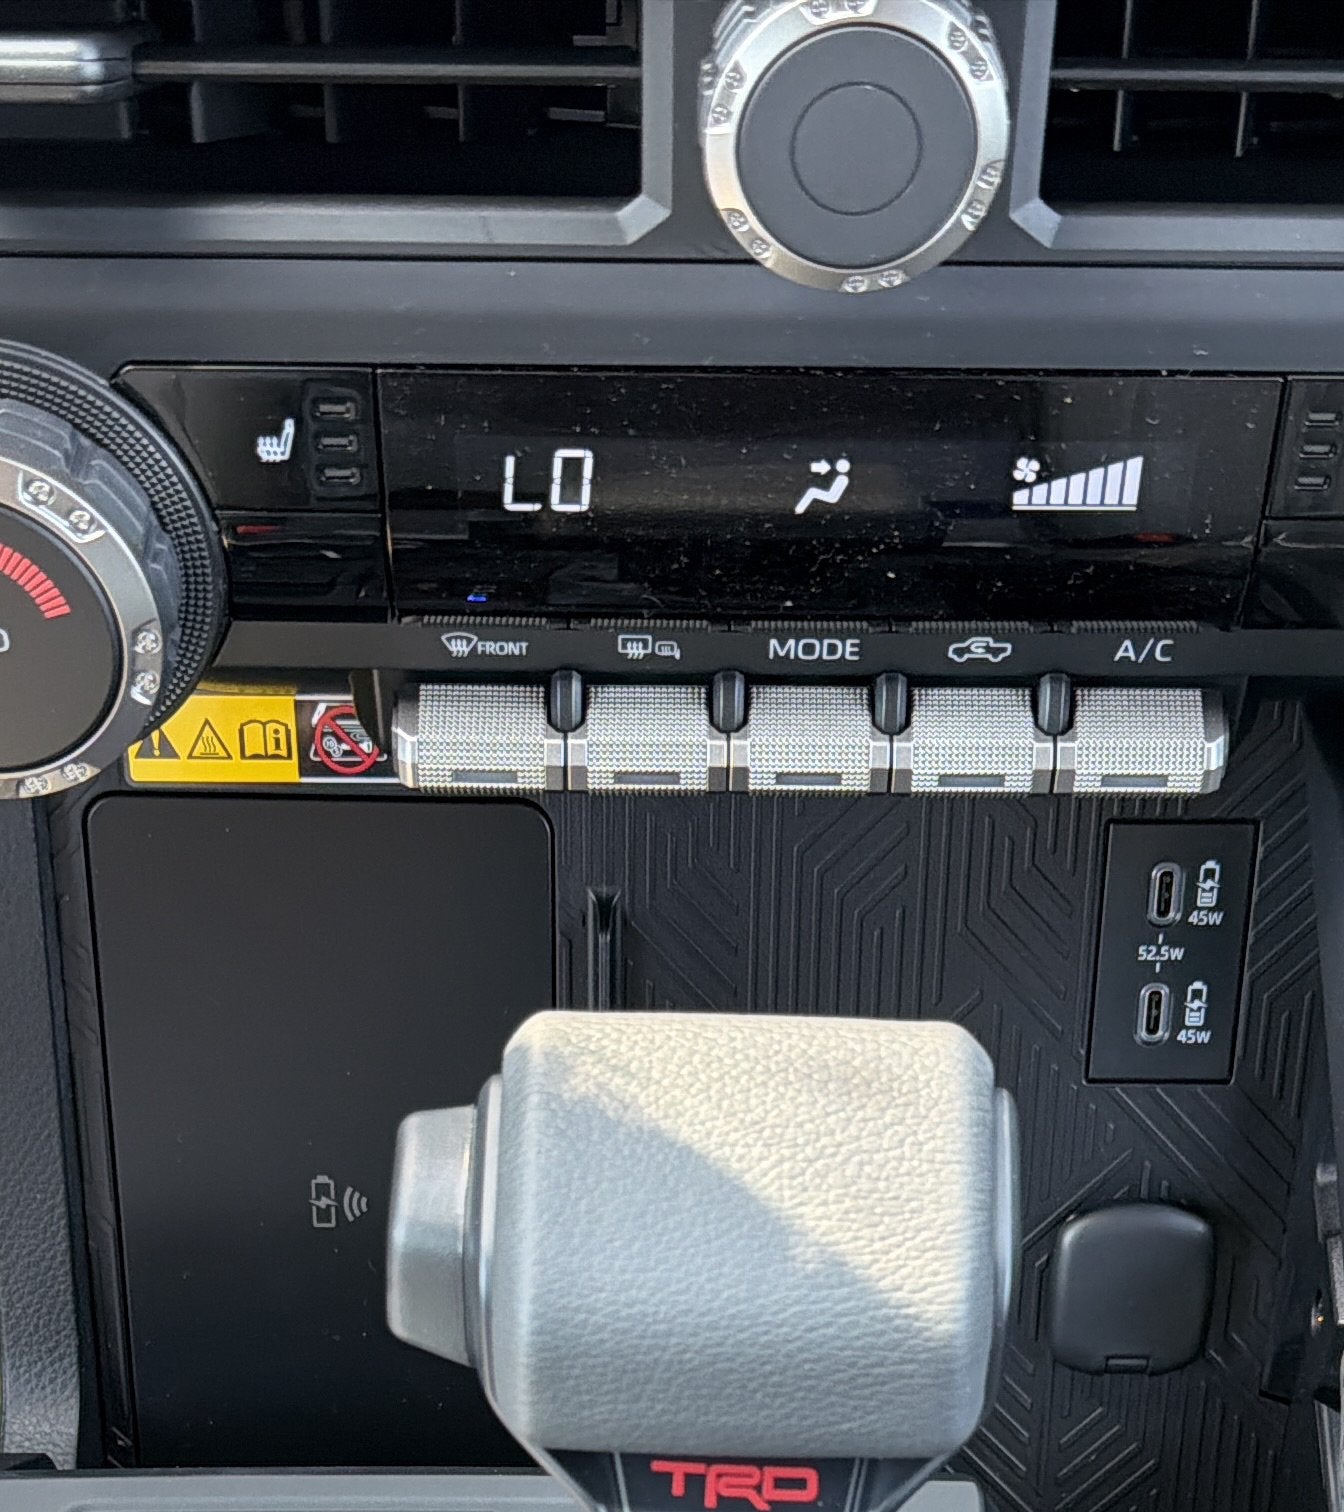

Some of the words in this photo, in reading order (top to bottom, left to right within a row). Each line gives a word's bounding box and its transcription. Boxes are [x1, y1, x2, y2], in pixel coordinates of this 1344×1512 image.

[477, 641, 529, 657] FRONT
[768, 638, 861, 661] MODE
[1114, 638, 1174, 663] A/C
[1187, 911, 1224, 926] 45W
[1137, 945, 1184, 961] 52.5W
[1176, 1029, 1212, 1044] 45W
[650, 1459, 819, 1511] TRD
